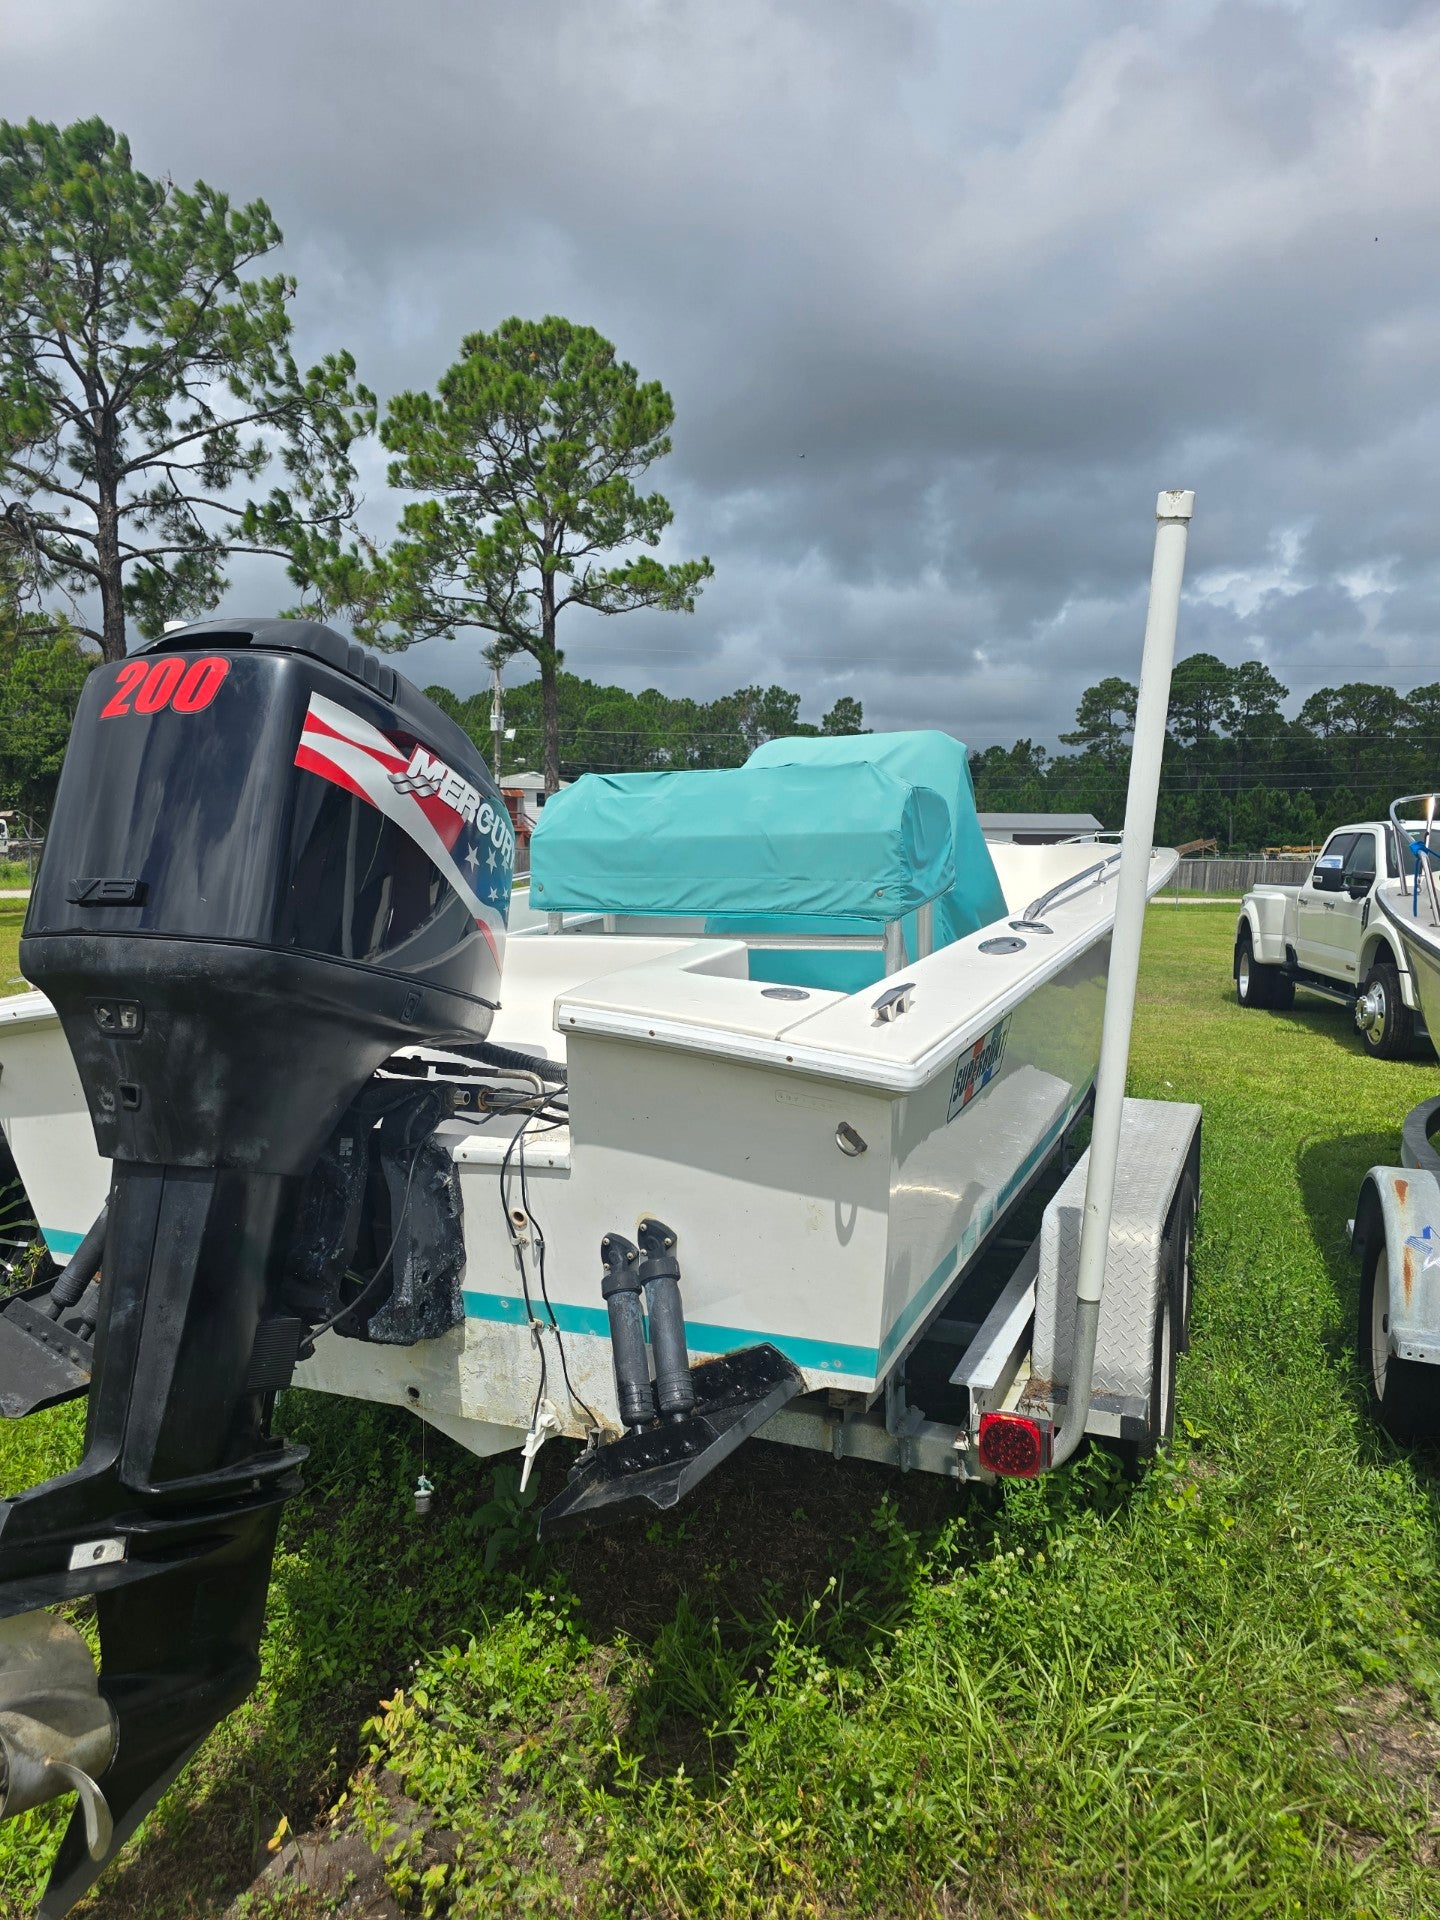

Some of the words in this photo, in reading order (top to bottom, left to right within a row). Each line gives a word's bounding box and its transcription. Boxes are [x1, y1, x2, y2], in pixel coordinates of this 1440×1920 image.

[100, 656, 231, 719] 200
[71, 878, 137, 901] V6
[952, 1028, 1008, 1103] SUPERBOAT
